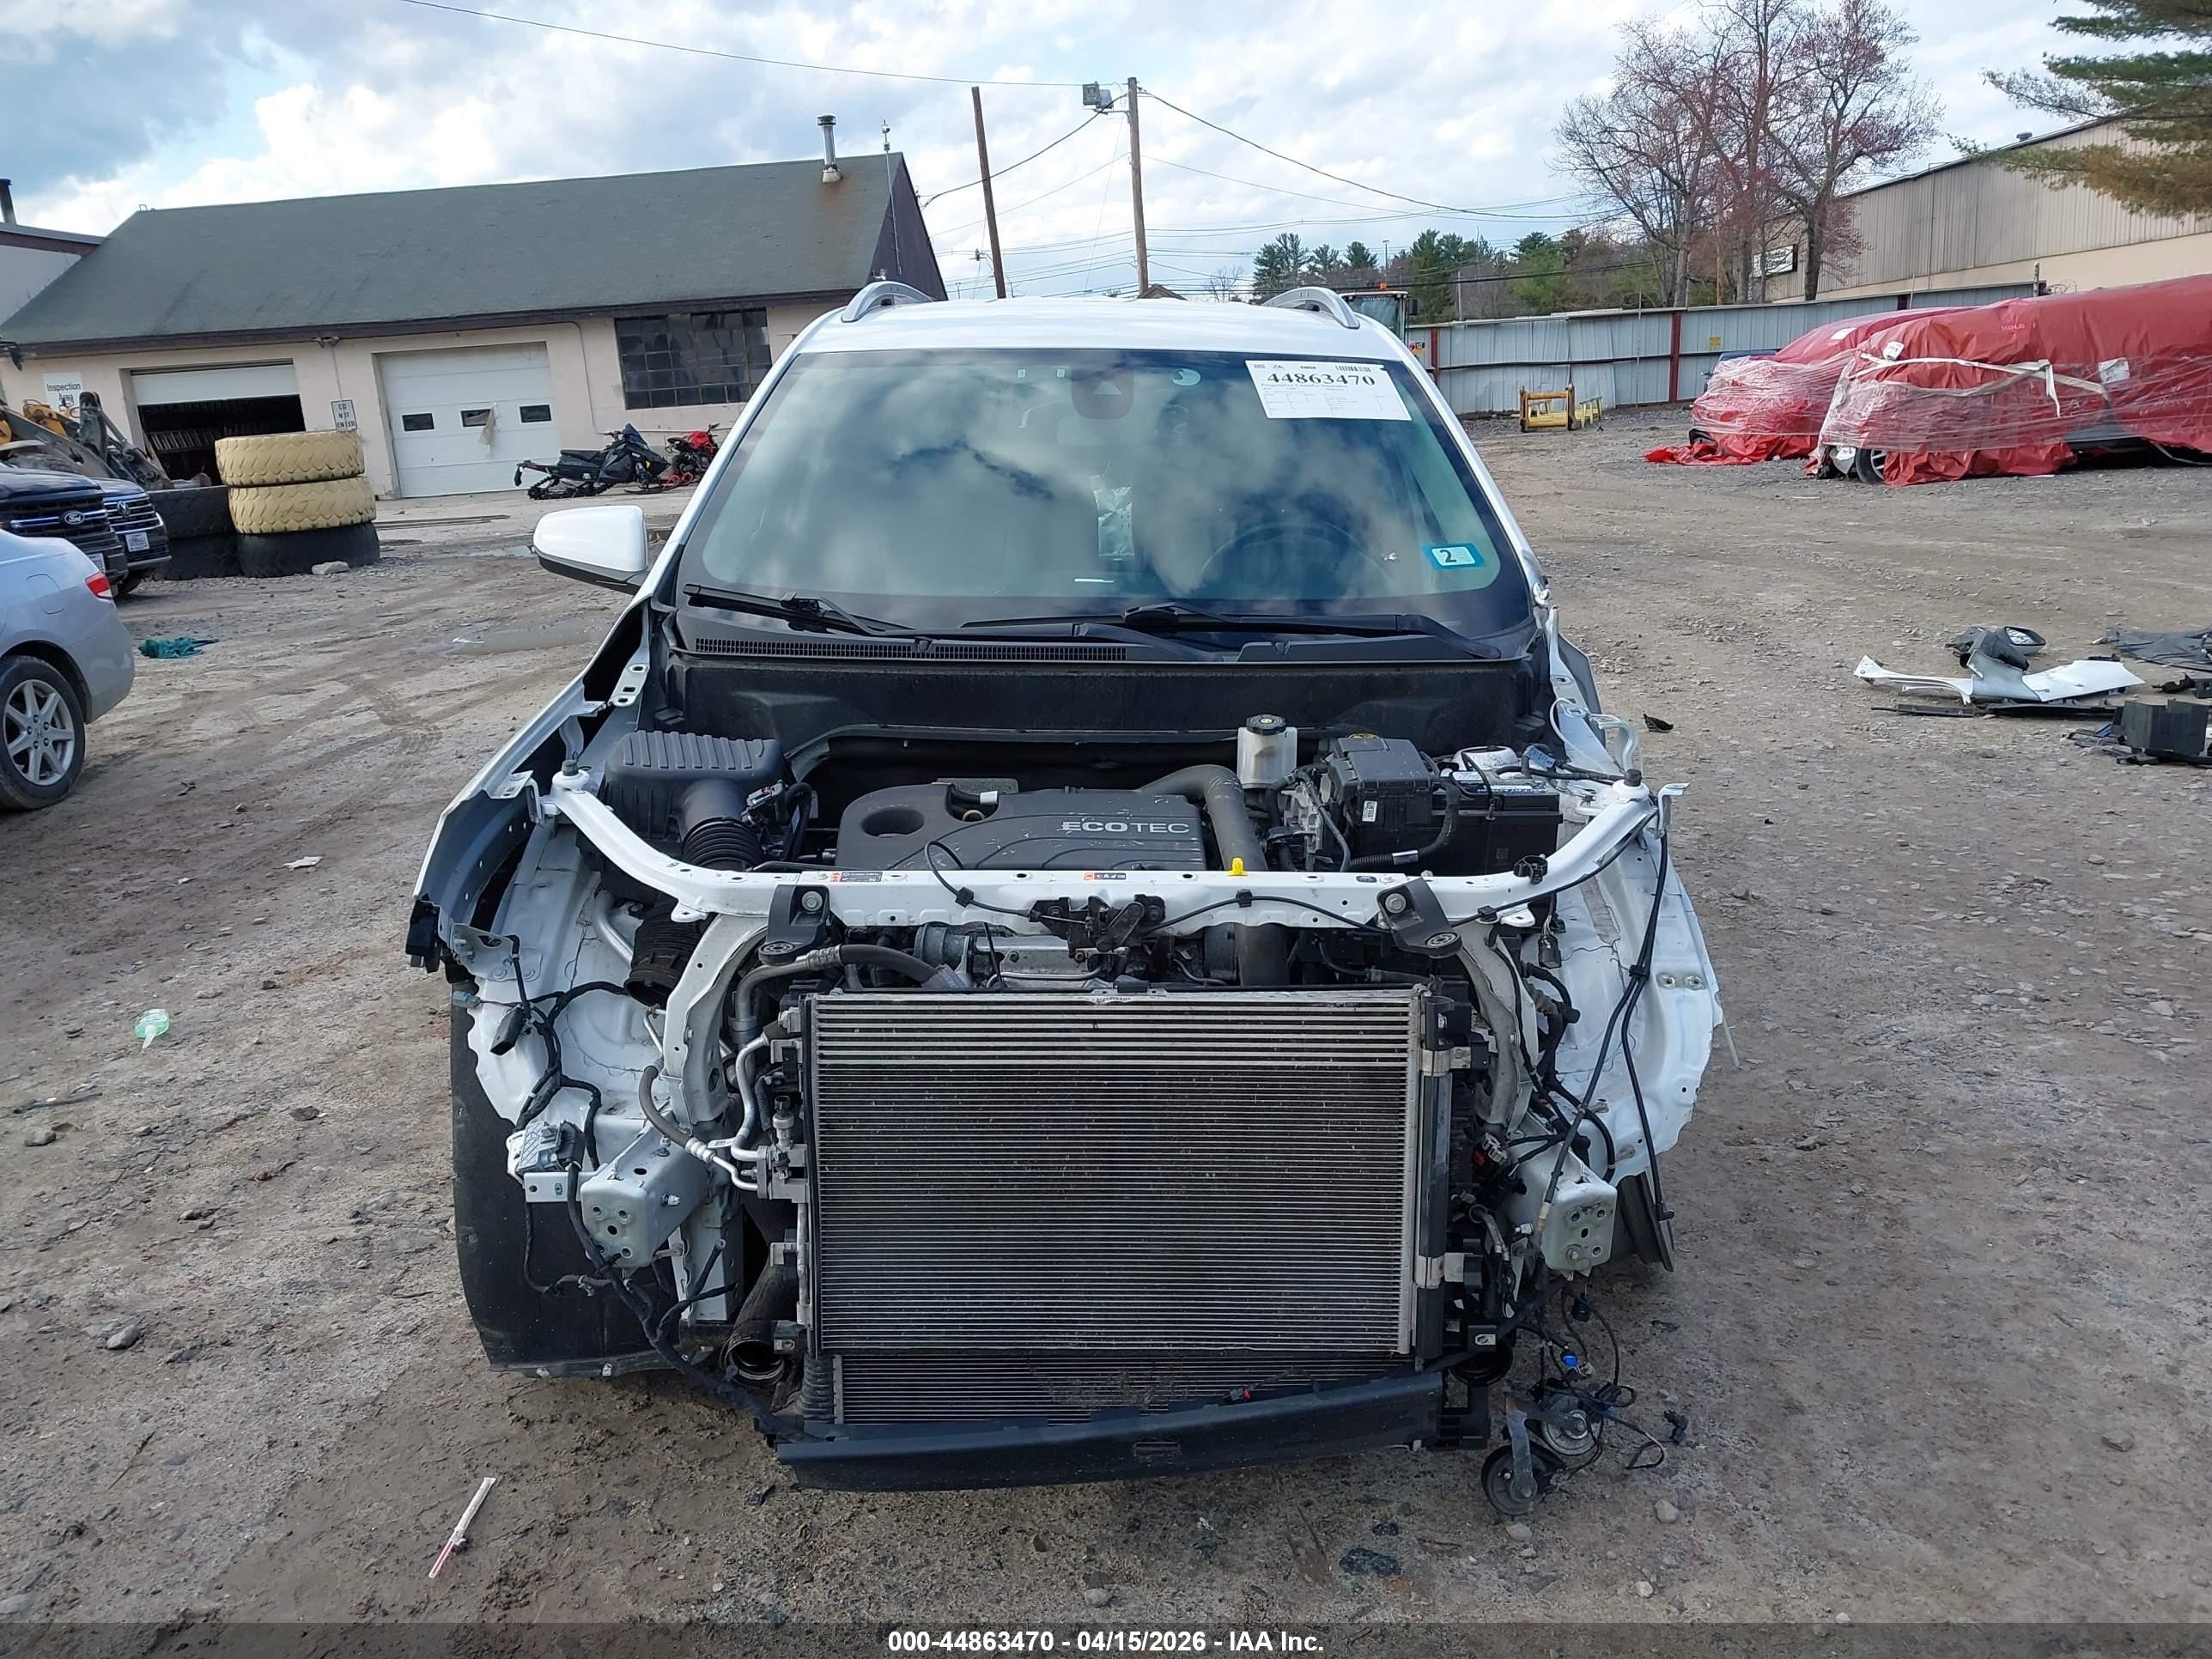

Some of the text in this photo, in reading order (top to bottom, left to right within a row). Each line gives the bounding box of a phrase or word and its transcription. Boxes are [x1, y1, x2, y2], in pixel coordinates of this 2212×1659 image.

[1267, 373, 1376, 386] 44863470
[46, 383, 82, 392] Inspection
[1439, 550, 1457, 563] 2
[1061, 821, 1189, 834] ECOTEC
